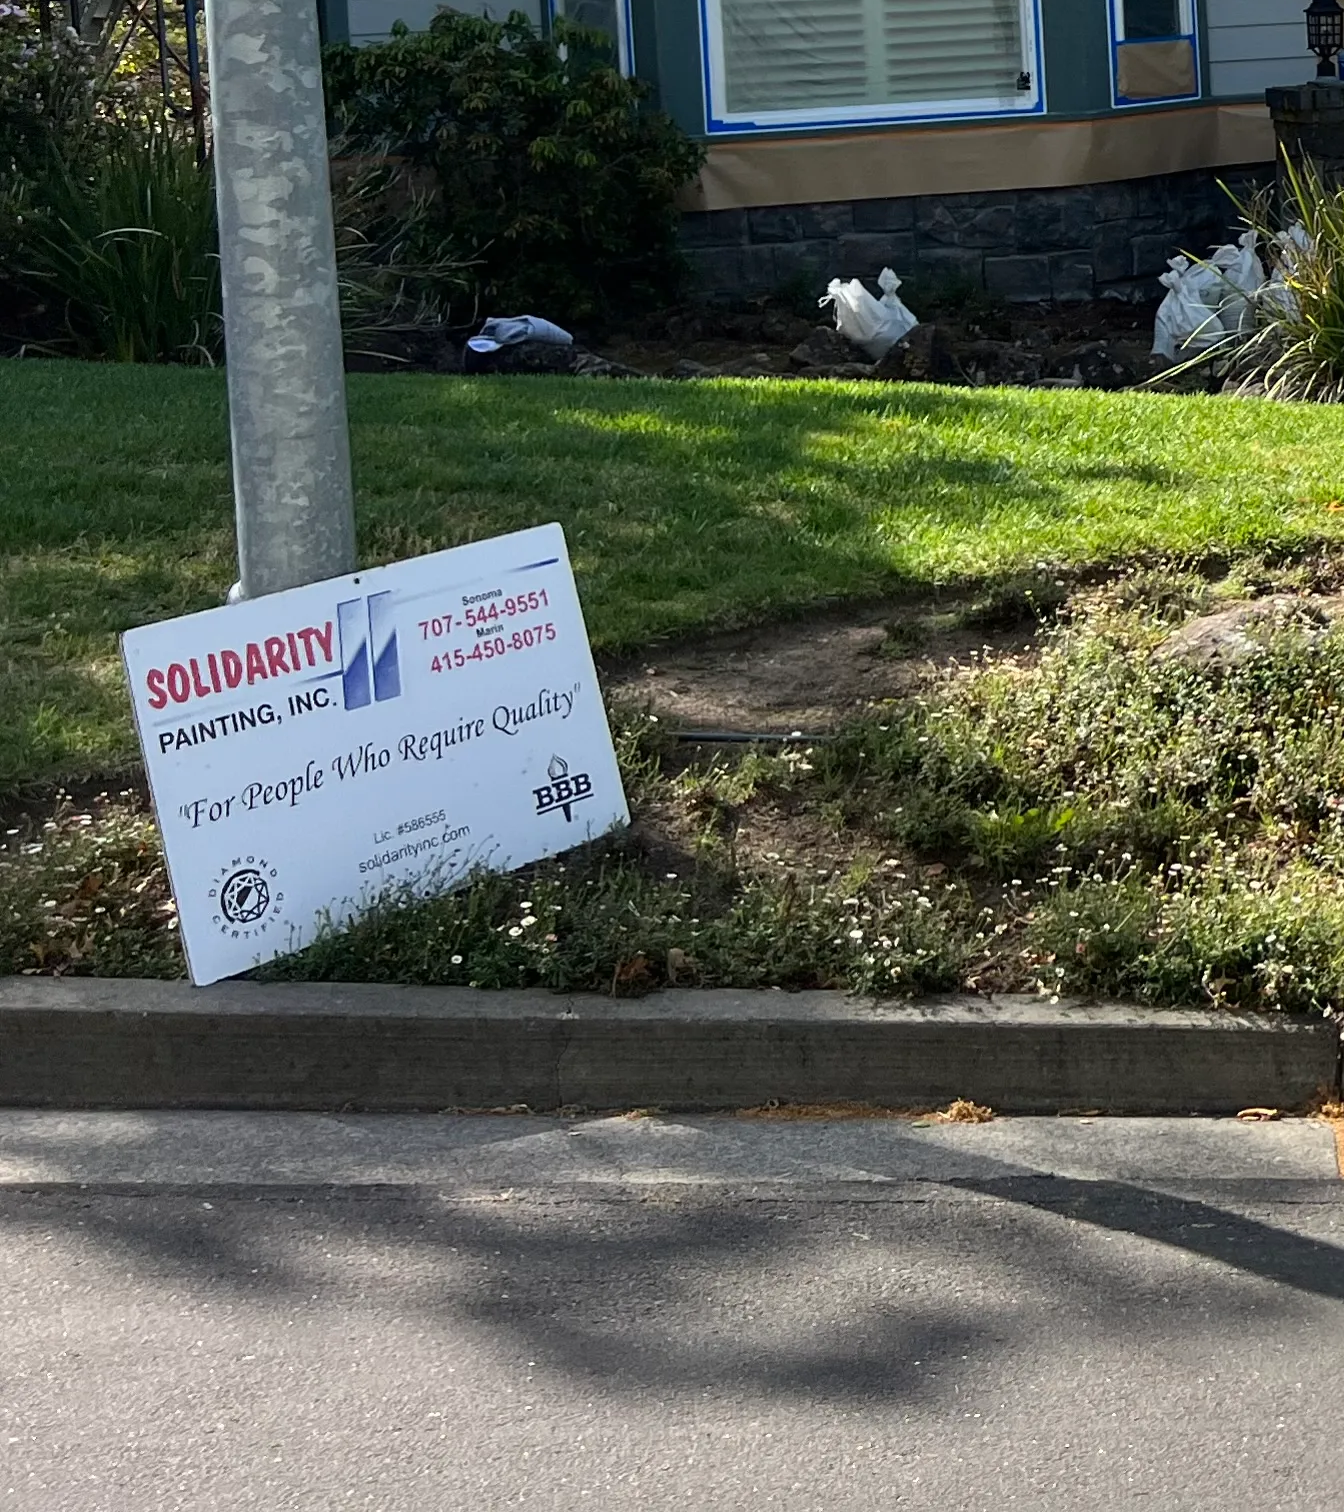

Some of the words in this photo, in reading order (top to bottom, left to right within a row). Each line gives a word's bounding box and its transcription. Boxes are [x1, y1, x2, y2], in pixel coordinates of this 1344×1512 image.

[462, 589, 503, 606] Sonoma
[431, 623, 557, 673] 415-450-8075
[476, 623, 504, 637] Marin
[147, 621, 332, 709] SOLIDARITY
[159, 704, 283, 754] PAINTING,
[288, 688, 337, 716] INC.
[179, 795, 236, 828] "For
[241, 760, 324, 810] People
[332, 742, 390, 780] Who
[398, 717, 484, 761] Require
[492, 682, 581, 735] Quality"
[532, 773, 592, 809] BBB
[397, 809, 447, 836] #586555
[358, 825, 471, 873] solidarityinc.com
[208, 855, 277, 898] DIAMOND
[212, 892, 284, 939] CERTIFIED
